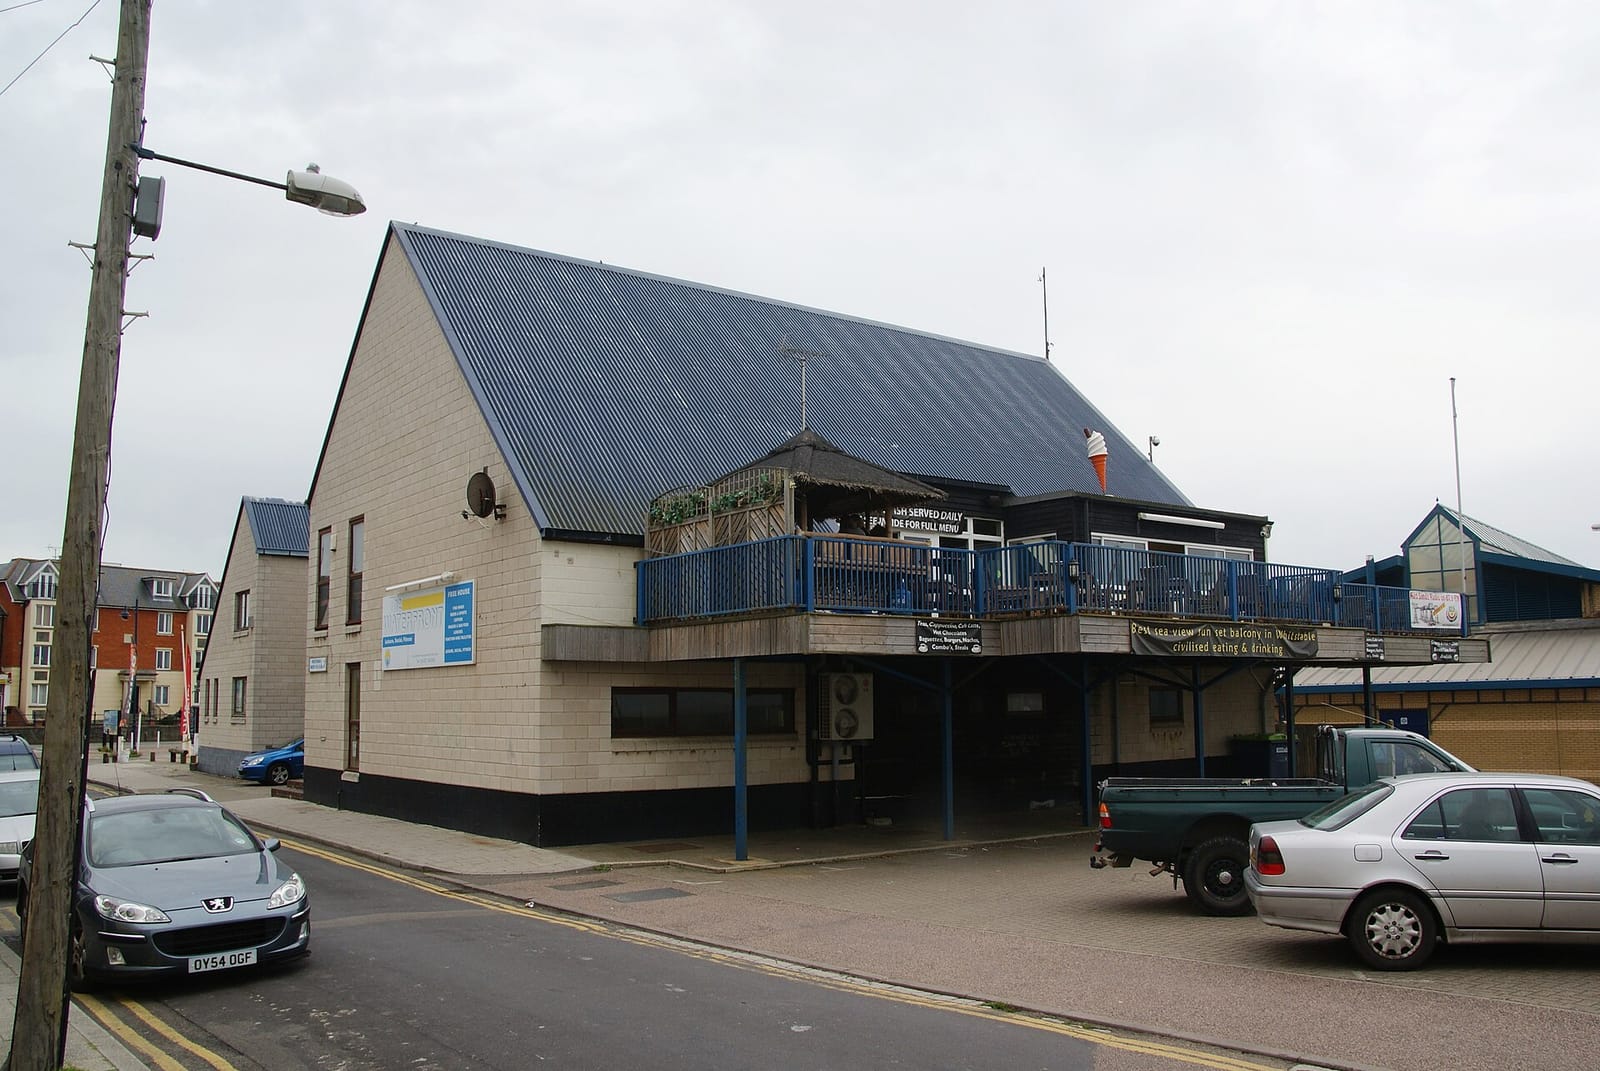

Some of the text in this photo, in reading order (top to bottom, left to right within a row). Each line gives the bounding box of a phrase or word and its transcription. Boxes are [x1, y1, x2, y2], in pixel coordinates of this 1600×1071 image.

[909, 508, 939, 519] SERVED
[940, 511, 963, 521] DAILY
[906, 520, 920, 529] FOR
[921, 521, 938, 531] FULL
[939, 523, 960, 533] MENU
[384, 606, 443, 632] WATERFRONT
[1131, 622, 1315, 641] Best sea view sun set balcony in Whitstable
[1173, 641, 1284, 656] civilised eating & drinking
[194, 952, 252, 970] OY54 OGF
